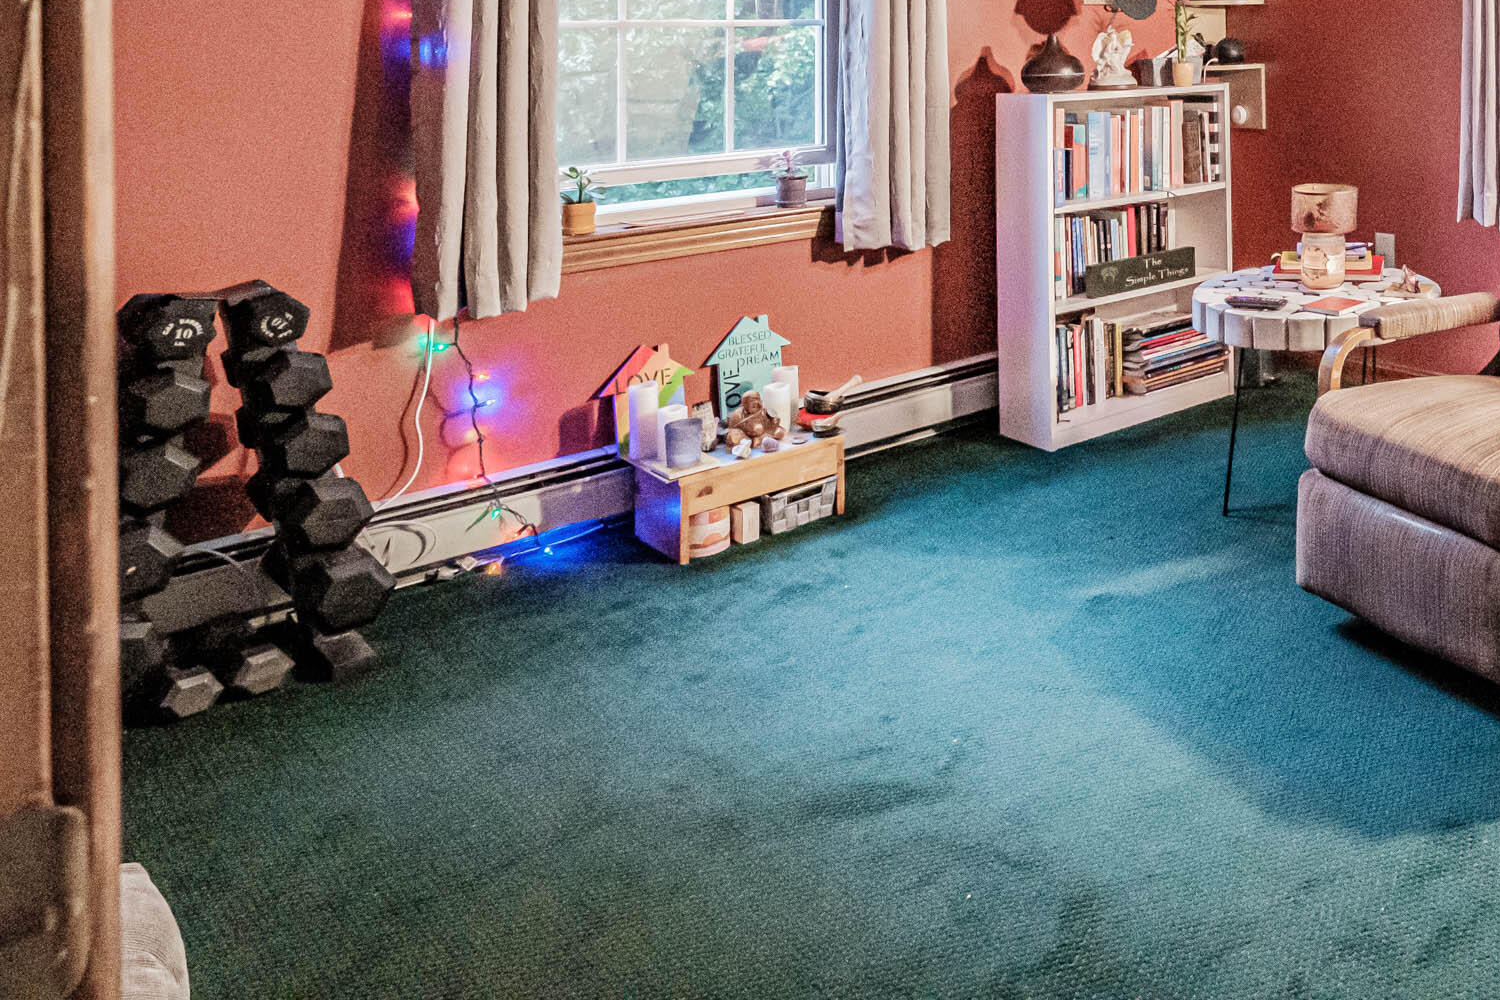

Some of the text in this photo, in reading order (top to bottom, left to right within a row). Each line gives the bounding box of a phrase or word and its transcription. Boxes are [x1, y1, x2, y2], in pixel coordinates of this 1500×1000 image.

[1143, 257, 1162, 269] The
[1124, 267, 1189, 287] Simple Things
[175, 328, 193, 339] 10
[728, 330, 772, 346] BLESSED
[717, 343, 768, 360] GRATEFUL
[739, 350, 780, 367] DREAM
[723, 362, 742, 408] OVE
